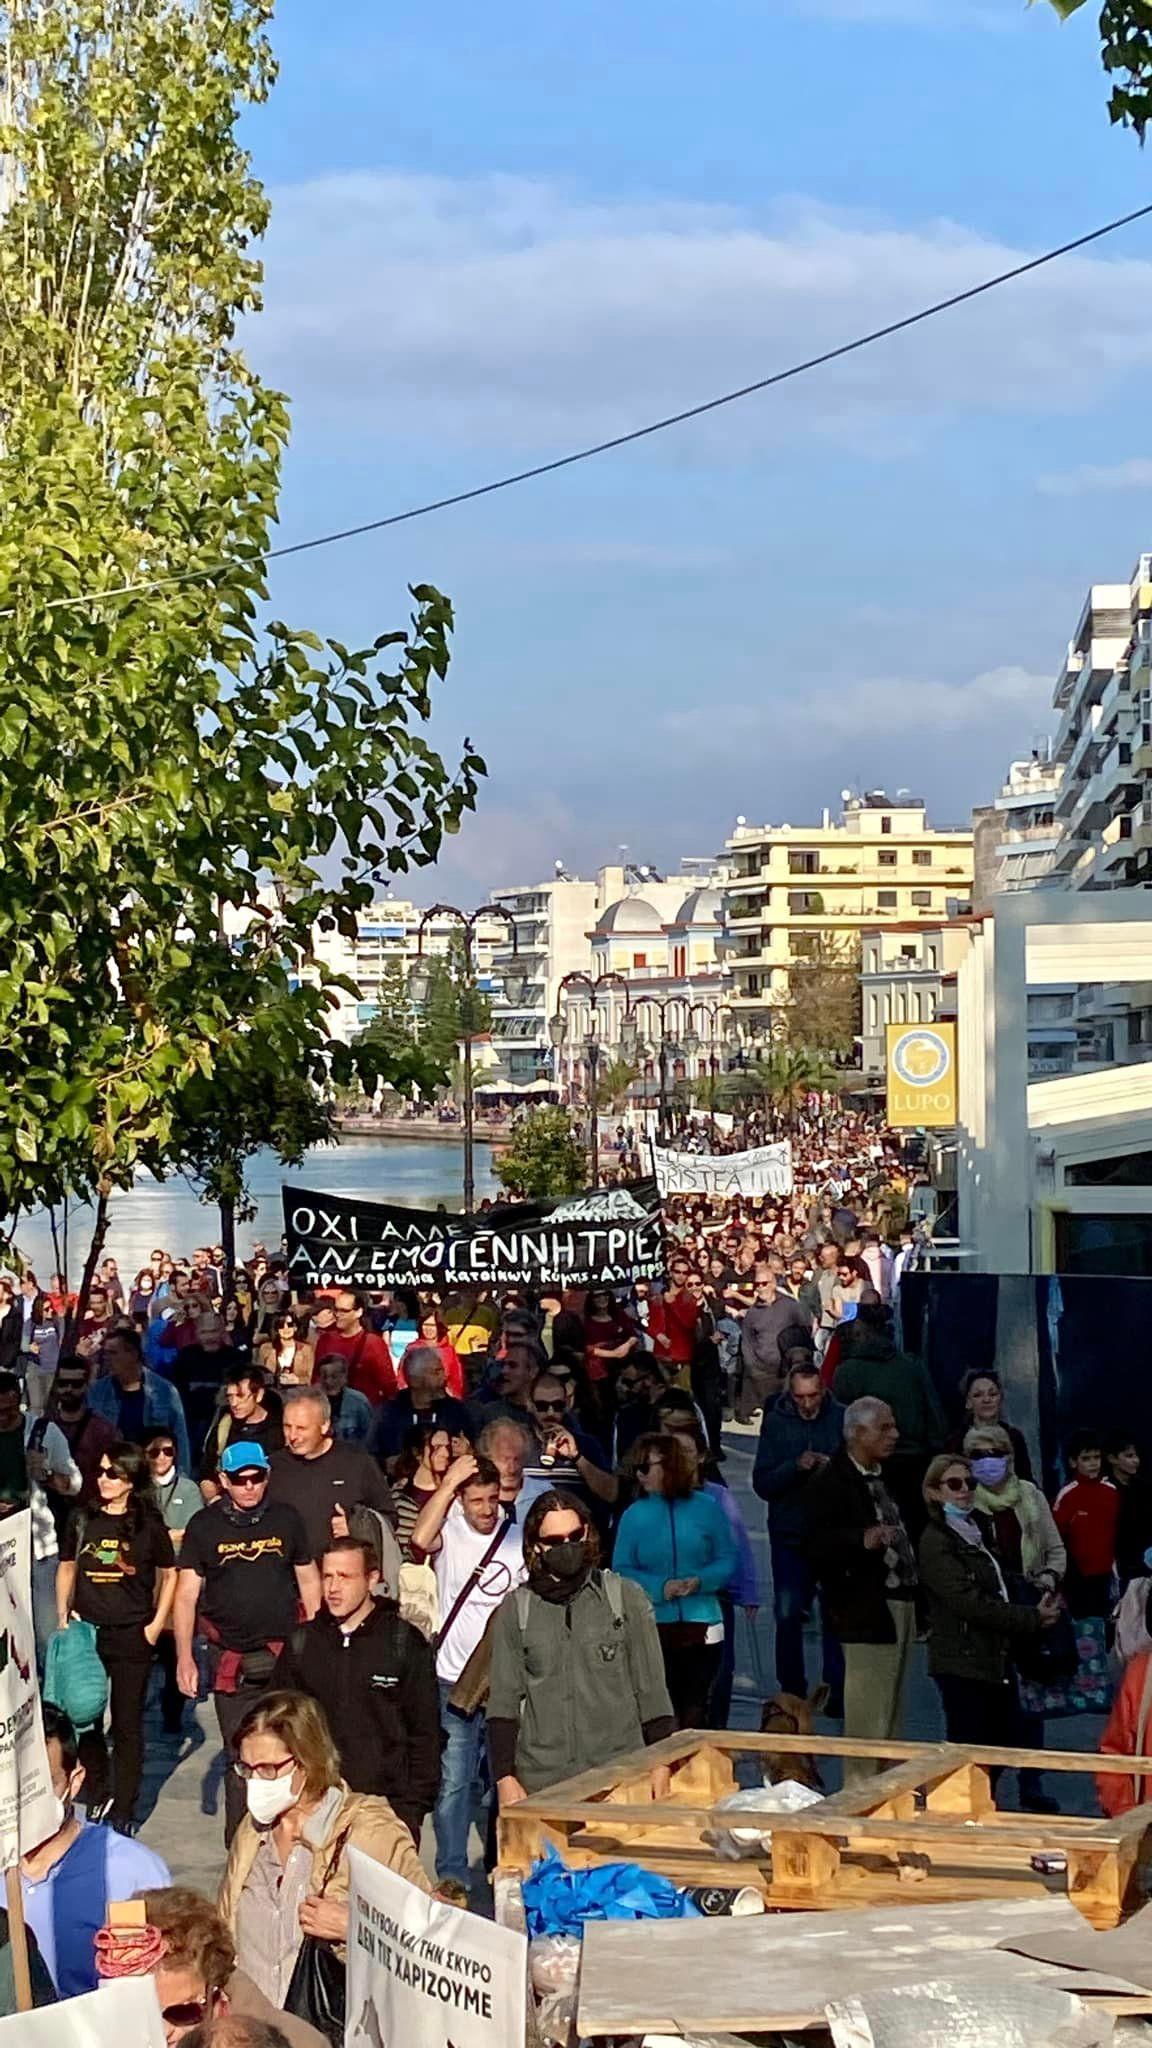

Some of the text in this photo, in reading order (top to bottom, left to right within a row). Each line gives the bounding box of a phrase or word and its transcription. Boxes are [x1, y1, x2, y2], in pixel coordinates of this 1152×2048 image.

[893, 1093, 951, 1112] LUPO
[292, 1207, 476, 1242] ΟΧΙ ΑΛΛΕ
[357, 1921, 493, 2019] ΔΕΝ ΤΙΣ ΧΑΡΙΖΟΥΜΕ
[400, 1928, 421, 1952] ΚΑΙ
[419, 1939, 445, 1965] ΤΗΝ
[445, 1950, 493, 1984] ΣΚΥΡΟ
